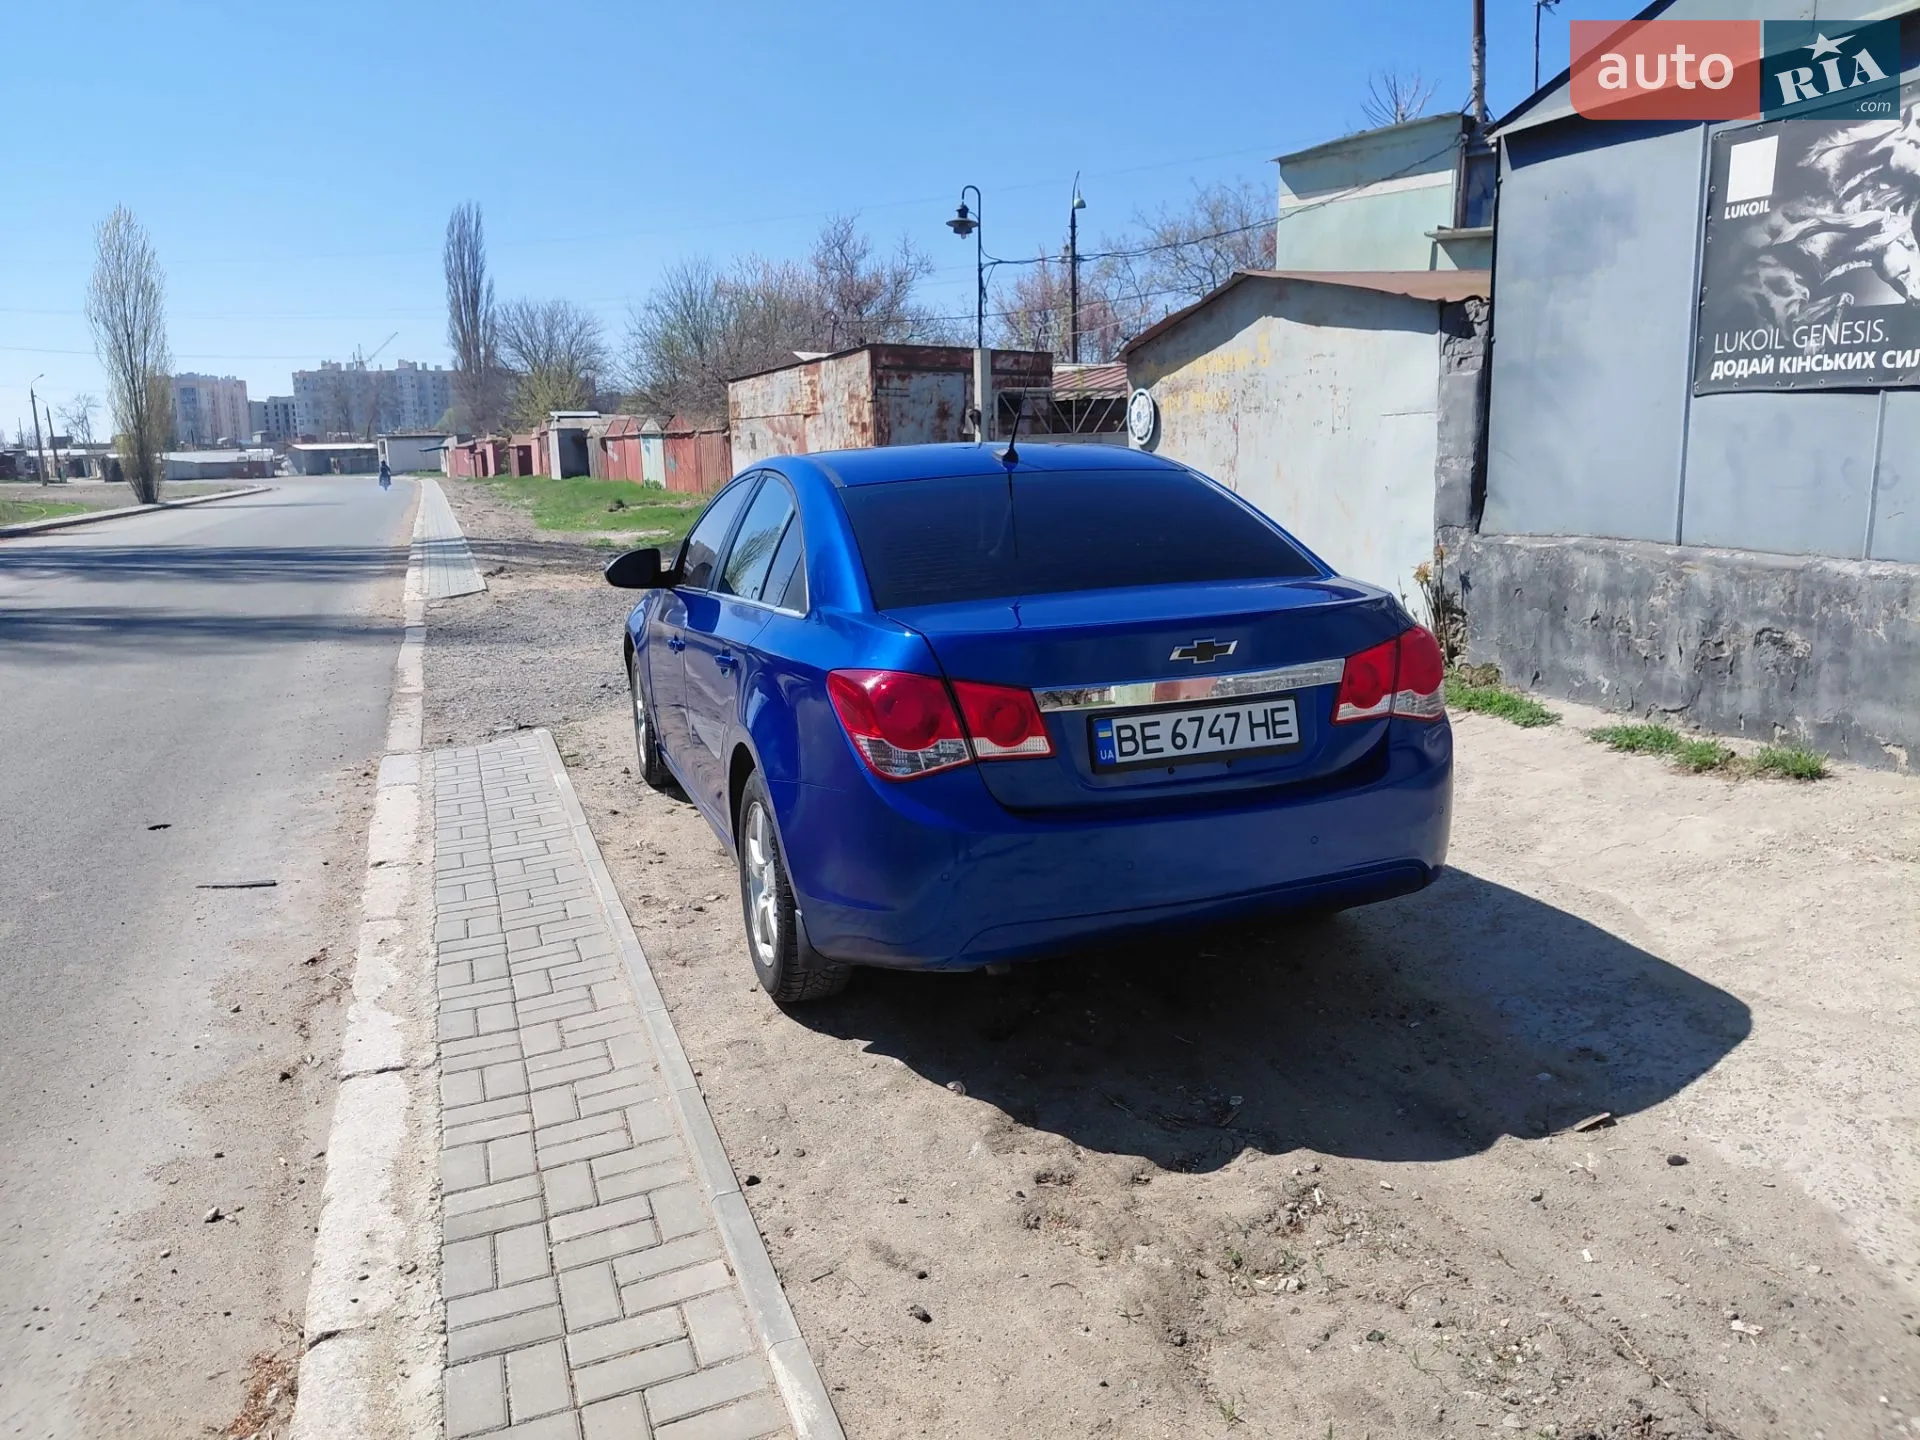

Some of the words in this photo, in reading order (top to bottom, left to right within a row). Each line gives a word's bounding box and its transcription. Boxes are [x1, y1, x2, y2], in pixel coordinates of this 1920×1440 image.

[1724, 200, 1770, 219] LUKOIL
[1714, 328, 1785, 353] LUKOIL
[1792, 319, 1890, 347] GENESIS.
[1711, 355, 1774, 381] ДОДАЙ
[1779, 351, 1876, 374] КІНСЬКИХ
[1116, 722, 1164, 757] BE
[1171, 712, 1240, 750] 6747
[1248, 706, 1293, 742] HE
[1100, 750, 1114, 760] UA
